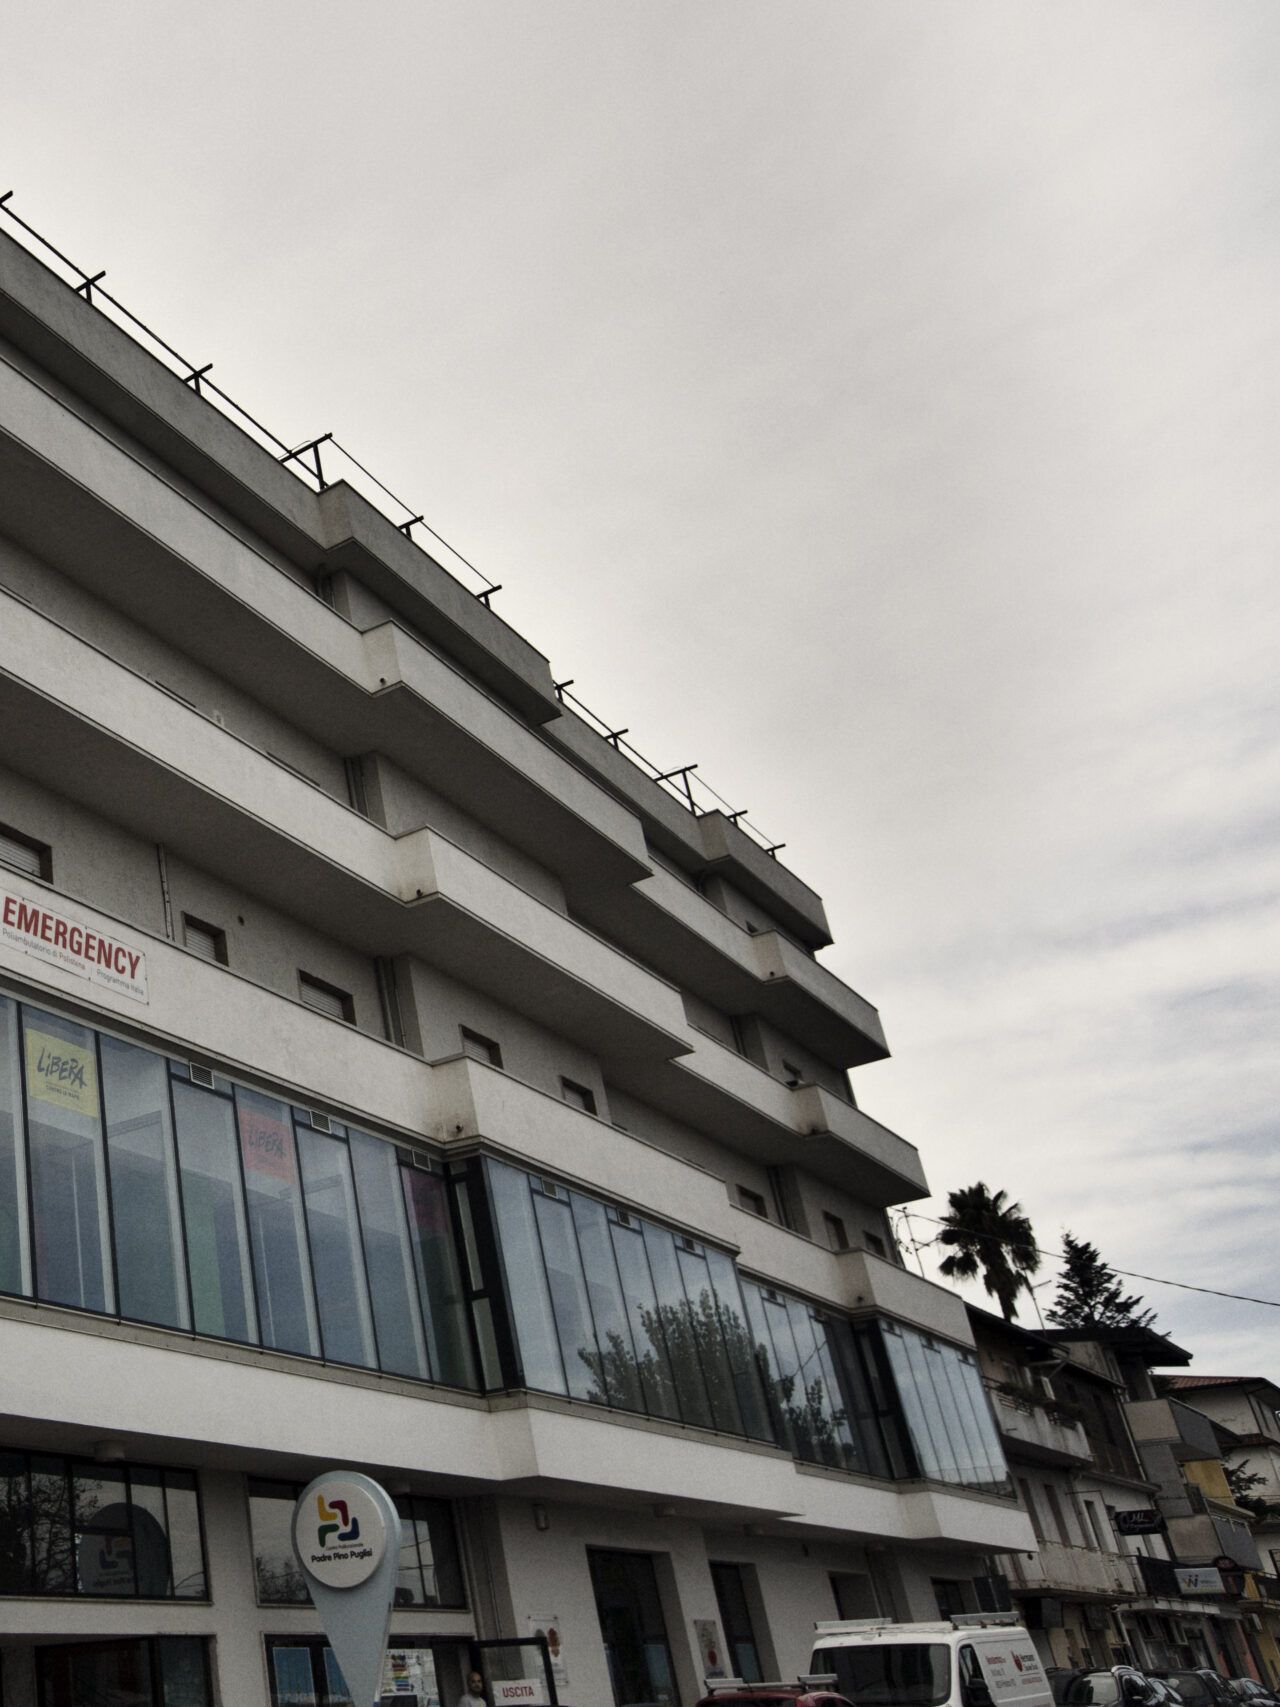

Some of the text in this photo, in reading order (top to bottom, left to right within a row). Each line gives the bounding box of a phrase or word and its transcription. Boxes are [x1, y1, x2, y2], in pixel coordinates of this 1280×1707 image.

[2, 896, 141, 979] EMERGENCY
[2, 927, 52, 956] Poliambulatorio
[311, 1547, 373, 1563] Padre Pino Puglisi
[501, 1685, 535, 1698] USCITA
